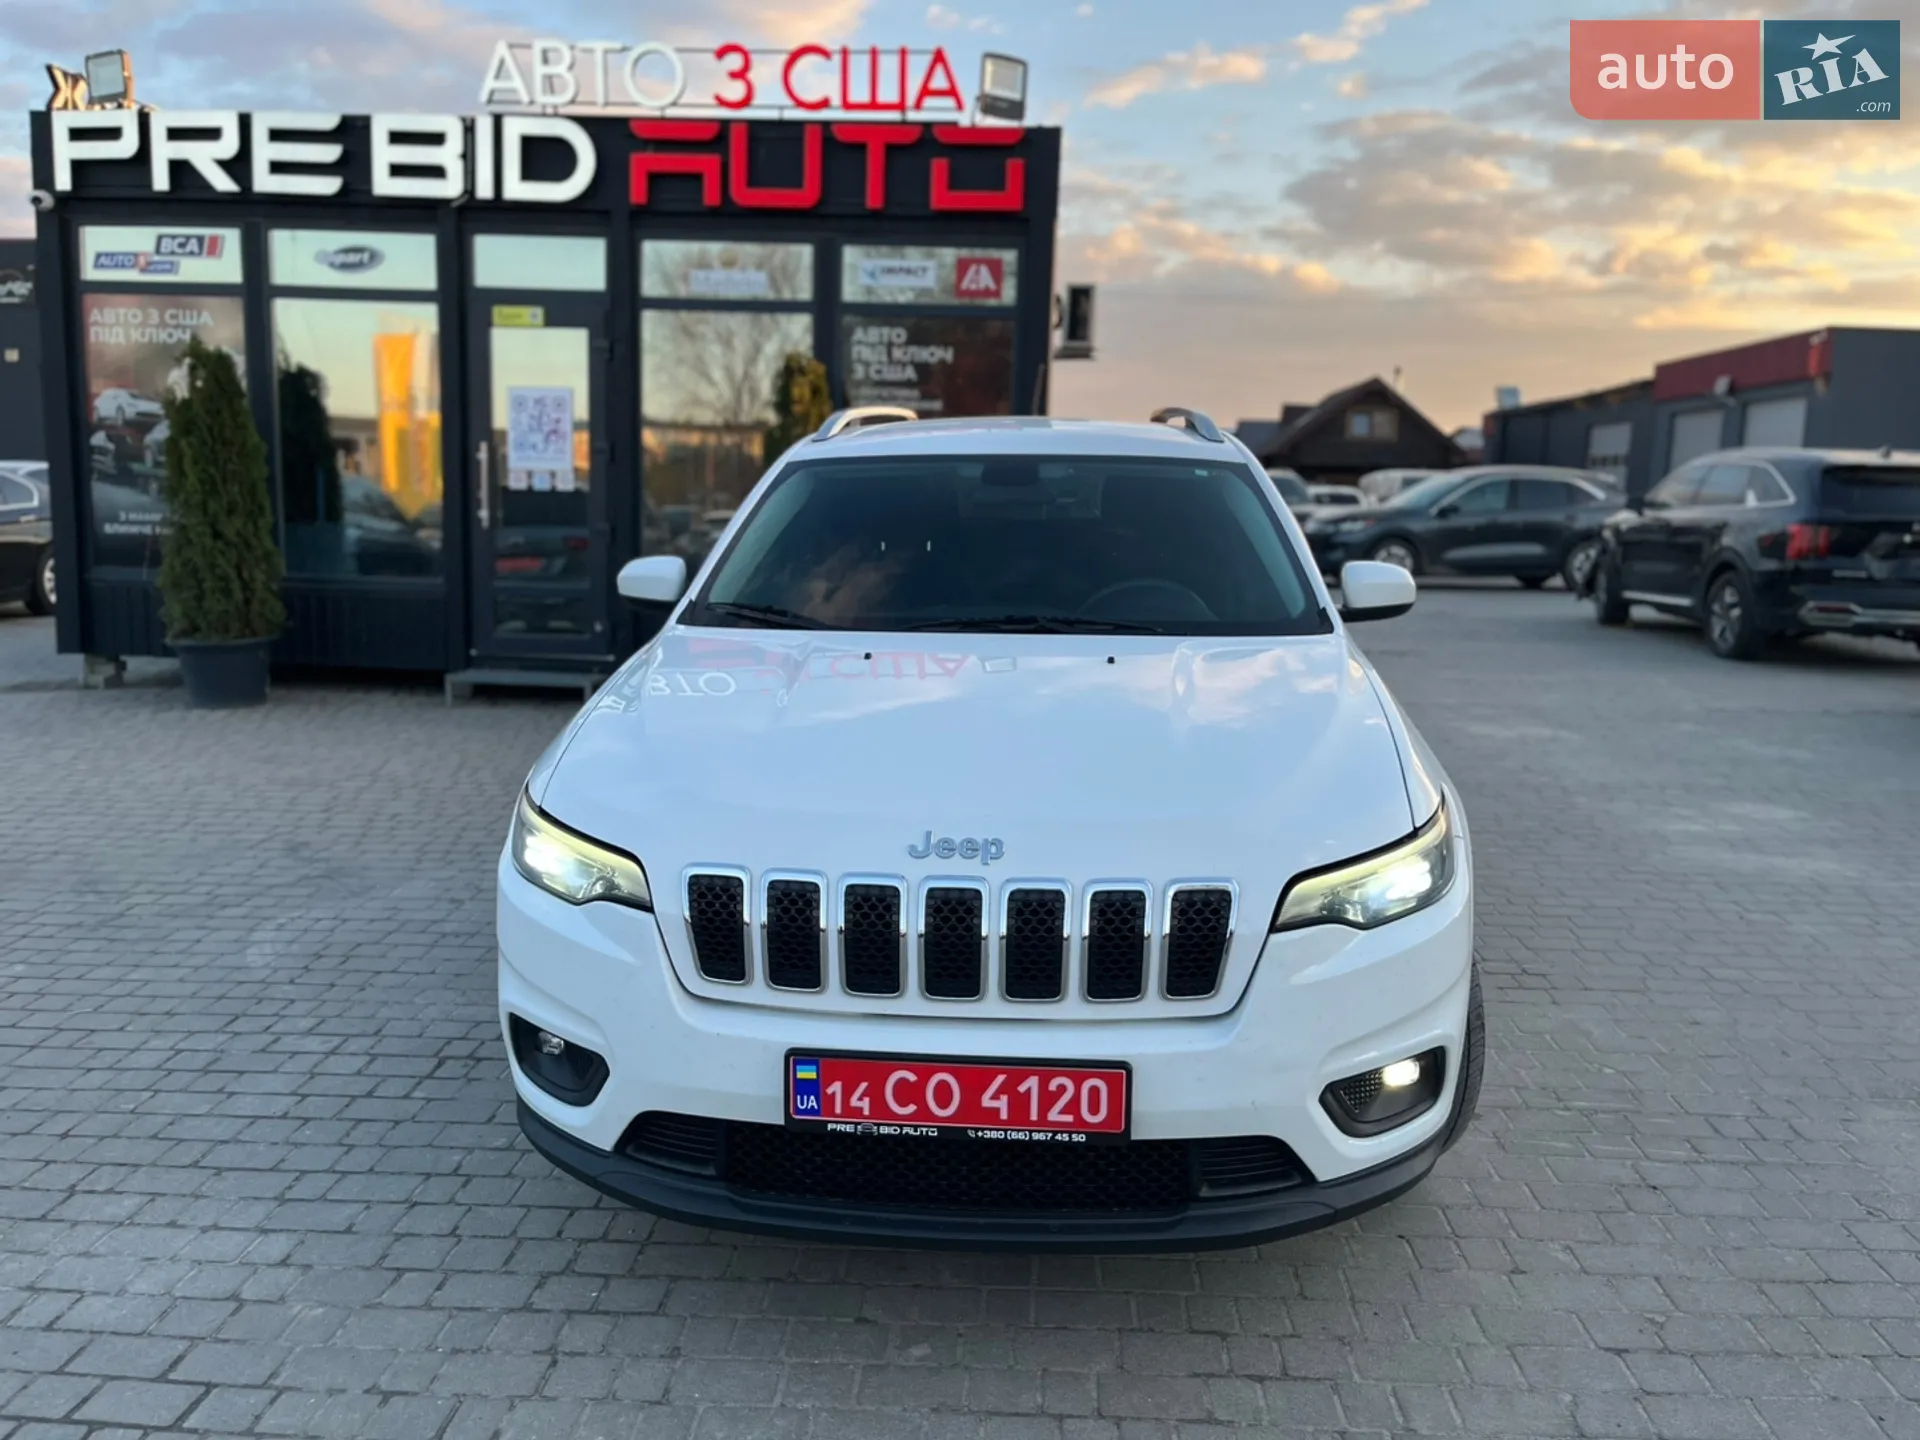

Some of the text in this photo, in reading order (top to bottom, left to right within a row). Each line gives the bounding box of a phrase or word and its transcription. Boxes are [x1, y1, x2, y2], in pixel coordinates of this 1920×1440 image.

[479, 39, 686, 109] АВТО
[782, 43, 965, 111] США
[51, 110, 1025, 211] PRE BID AUTO
[160, 236, 200, 255] BCA
[90, 308, 142, 325] АВТО
[164, 309, 214, 327] США
[90, 326, 192, 345] ПІД КЛЮЧ
[852, 326, 908, 345] АВТО
[907, 830, 1006, 866] Jeep
[797, 1070, 1109, 1124] UA 14 CO 4120
[827, 1123, 855, 1132] PRE
[902, 1126, 938, 1137] AUTO
[976, 1130, 1005, 1139] +380
[1054, 1132, 1069, 1141] 45
[1071, 1133, 1086, 1142] 50
